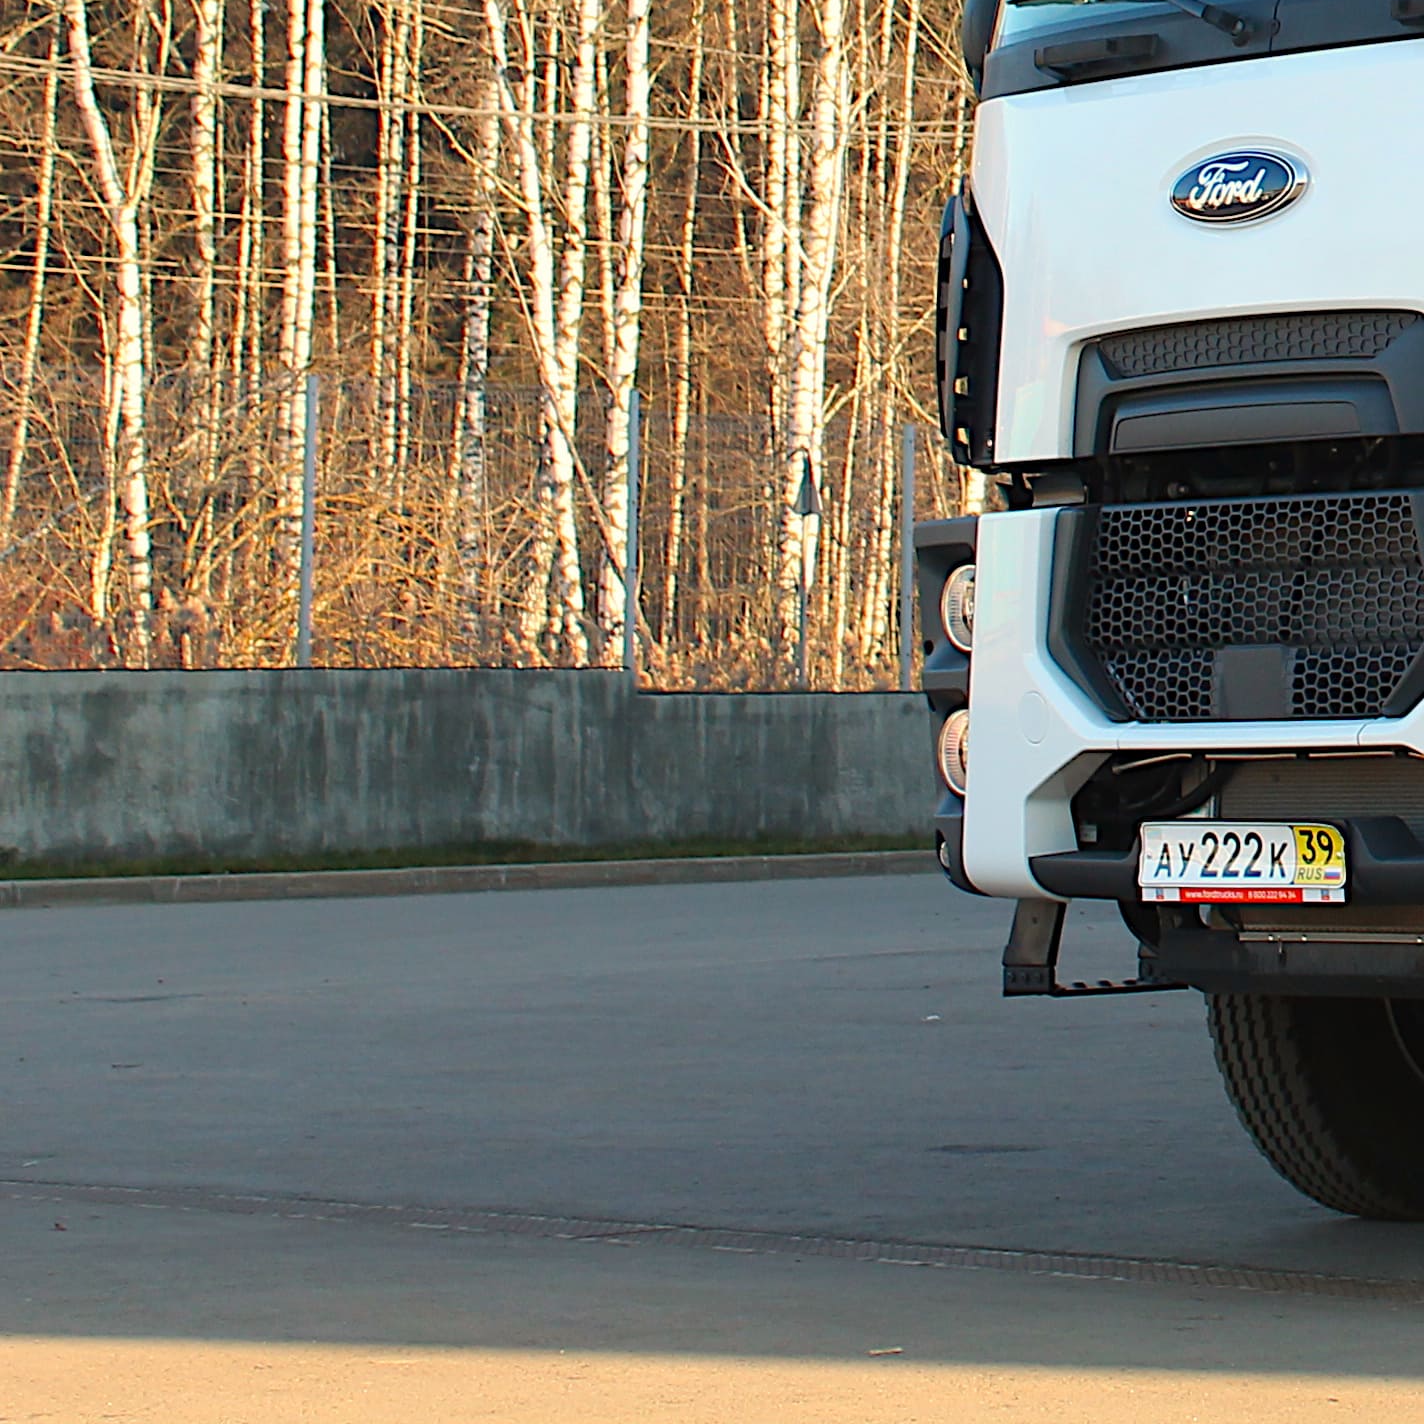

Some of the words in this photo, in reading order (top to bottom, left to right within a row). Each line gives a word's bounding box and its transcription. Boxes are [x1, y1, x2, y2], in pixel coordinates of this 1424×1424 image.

[1188, 160, 1266, 211] Ford
[1298, 830, 1334, 865] 39
[1297, 867, 1323, 880] RUS
